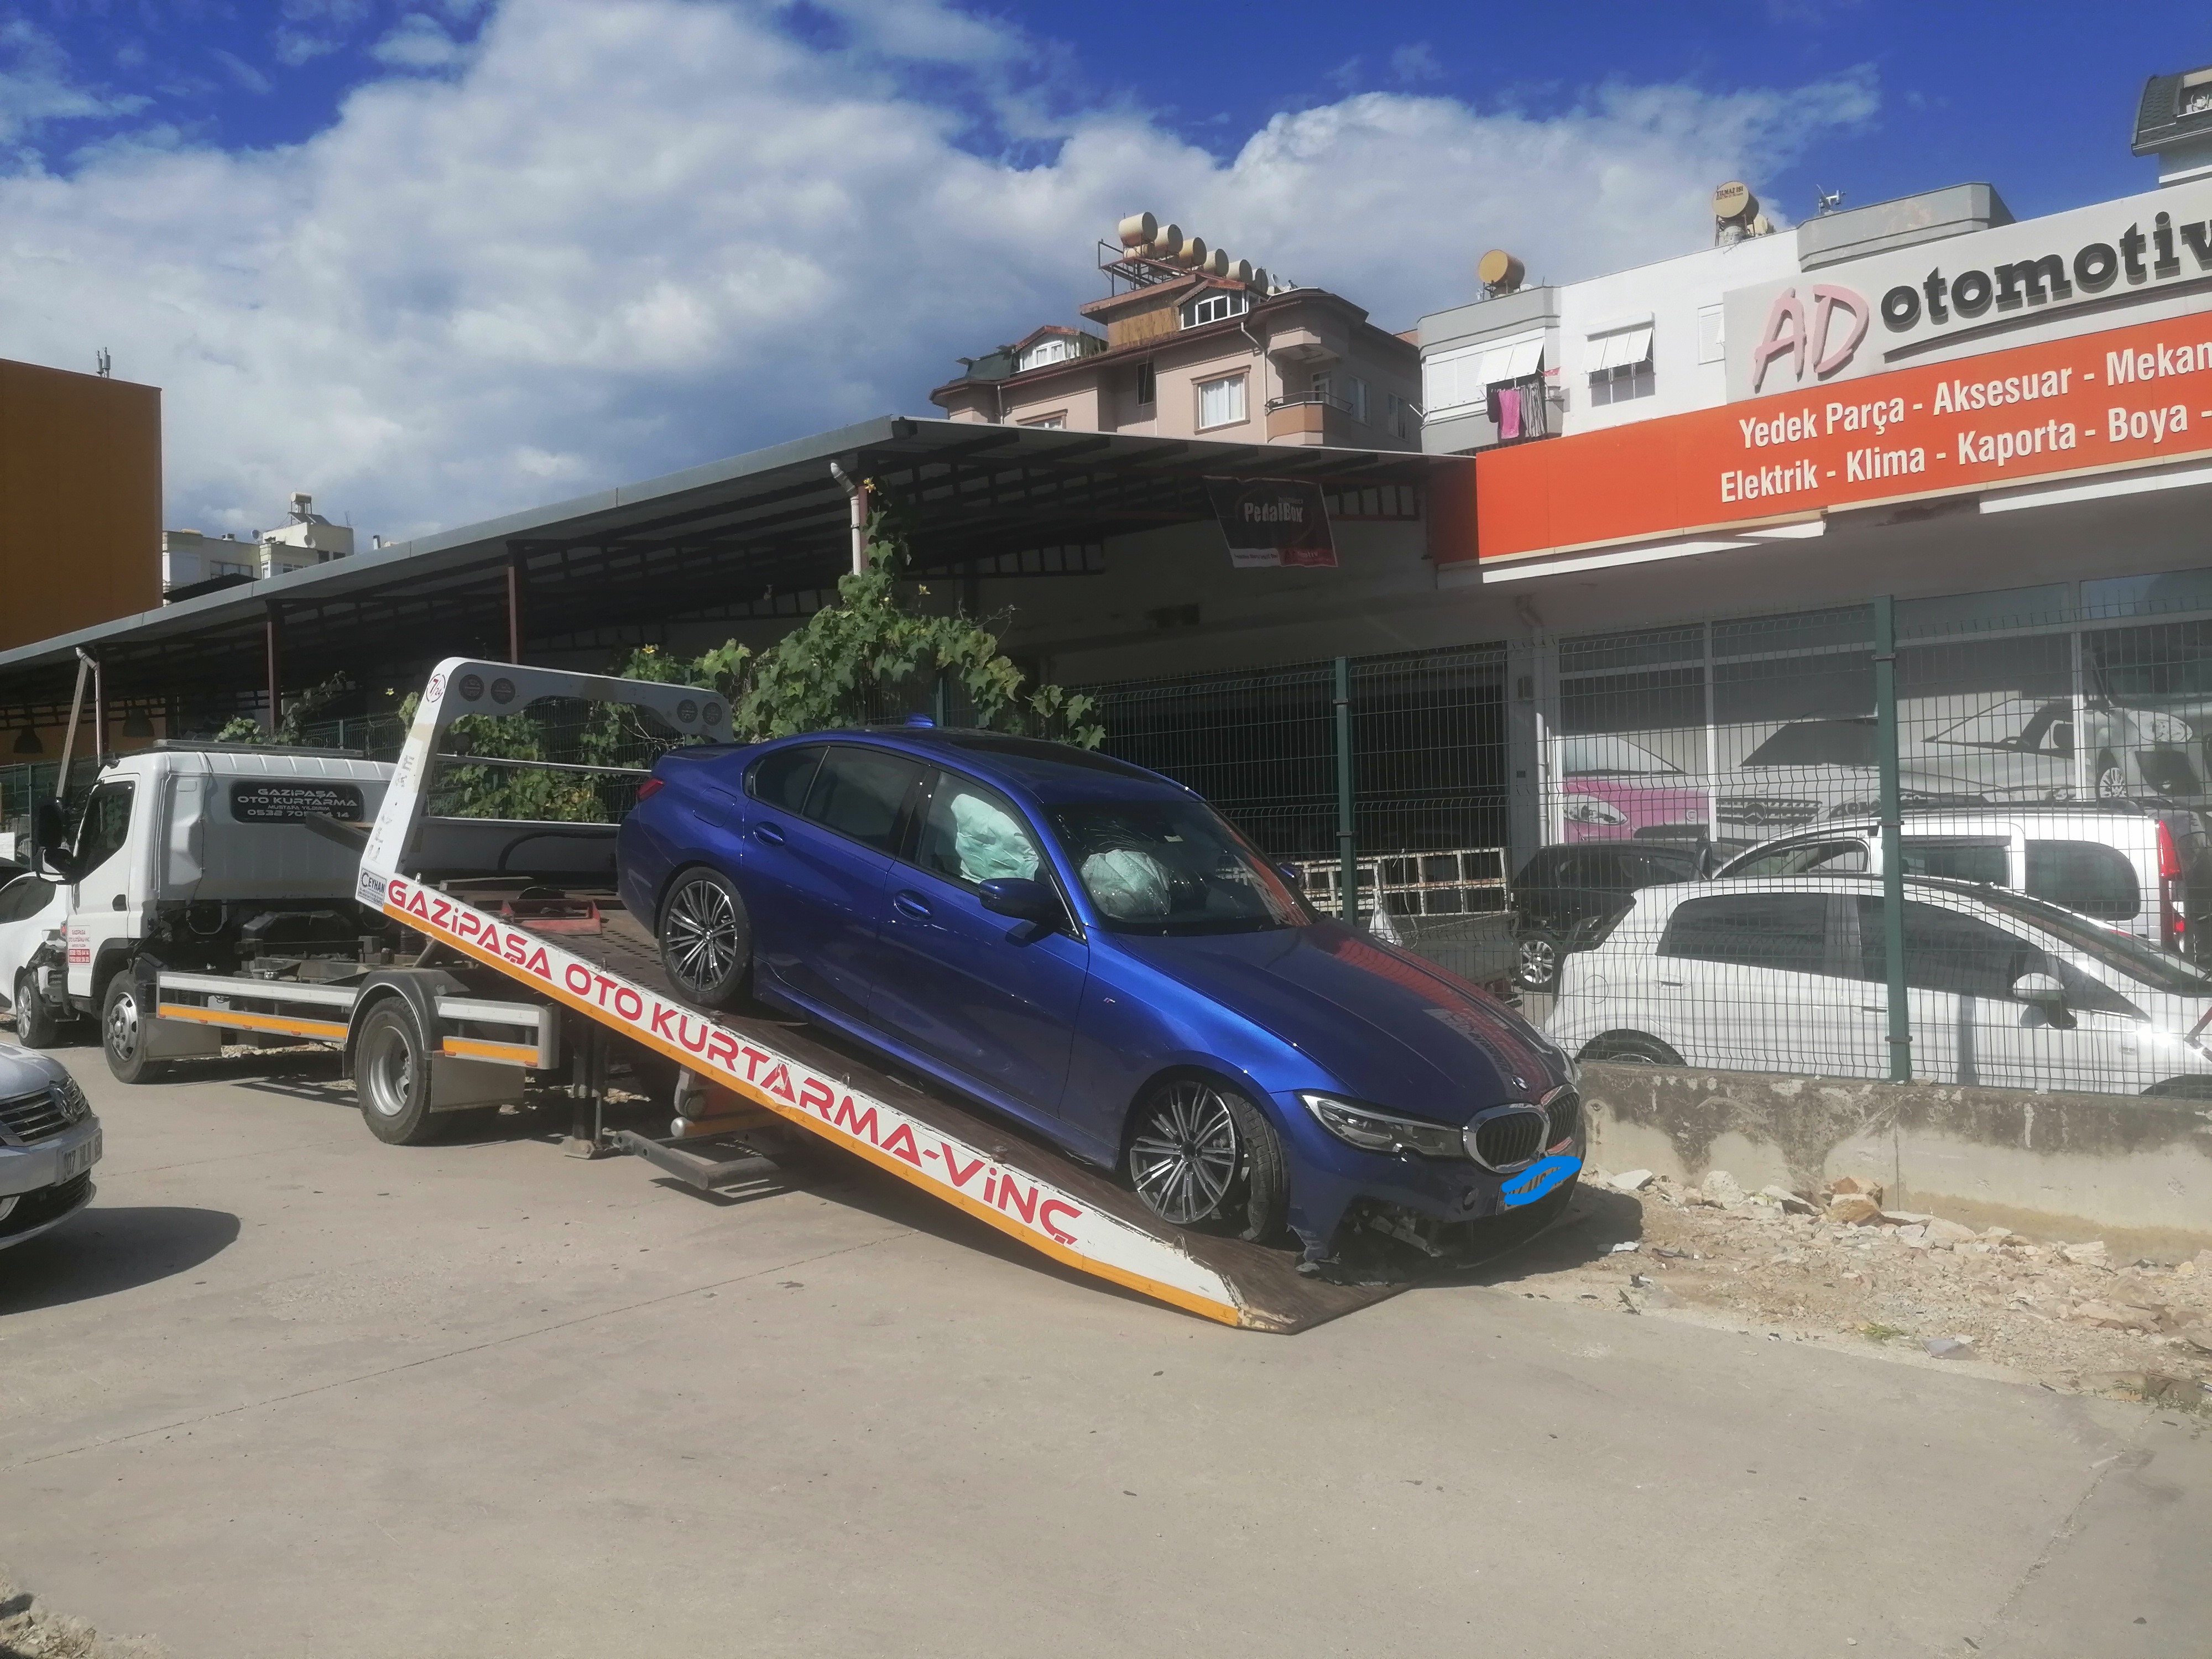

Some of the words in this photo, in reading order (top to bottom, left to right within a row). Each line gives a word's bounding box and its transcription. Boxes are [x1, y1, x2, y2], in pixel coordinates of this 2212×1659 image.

[1753, 283, 1870, 393] AD
[1881, 211, 2212, 328] otomotiv
[1739, 408, 1818, 448] Yedek
[1826, 397, 1905, 436] Parça
[1933, 367, 2073, 415] Aksesuar
[2106, 342, 2212, 386] Mekan
[1721, 458, 1819, 503] Elektrik
[1846, 446, 1926, 483] Klima
[1958, 419, 2076, 467] Kaporta
[2108, 404, 2188, 444] Boya
[237, 796, 269, 804] OTO
[273, 797, 358, 807] KURTARMA
[361, 872, 385, 894] CEYHAN
[565, 964, 643, 1021] OTO
